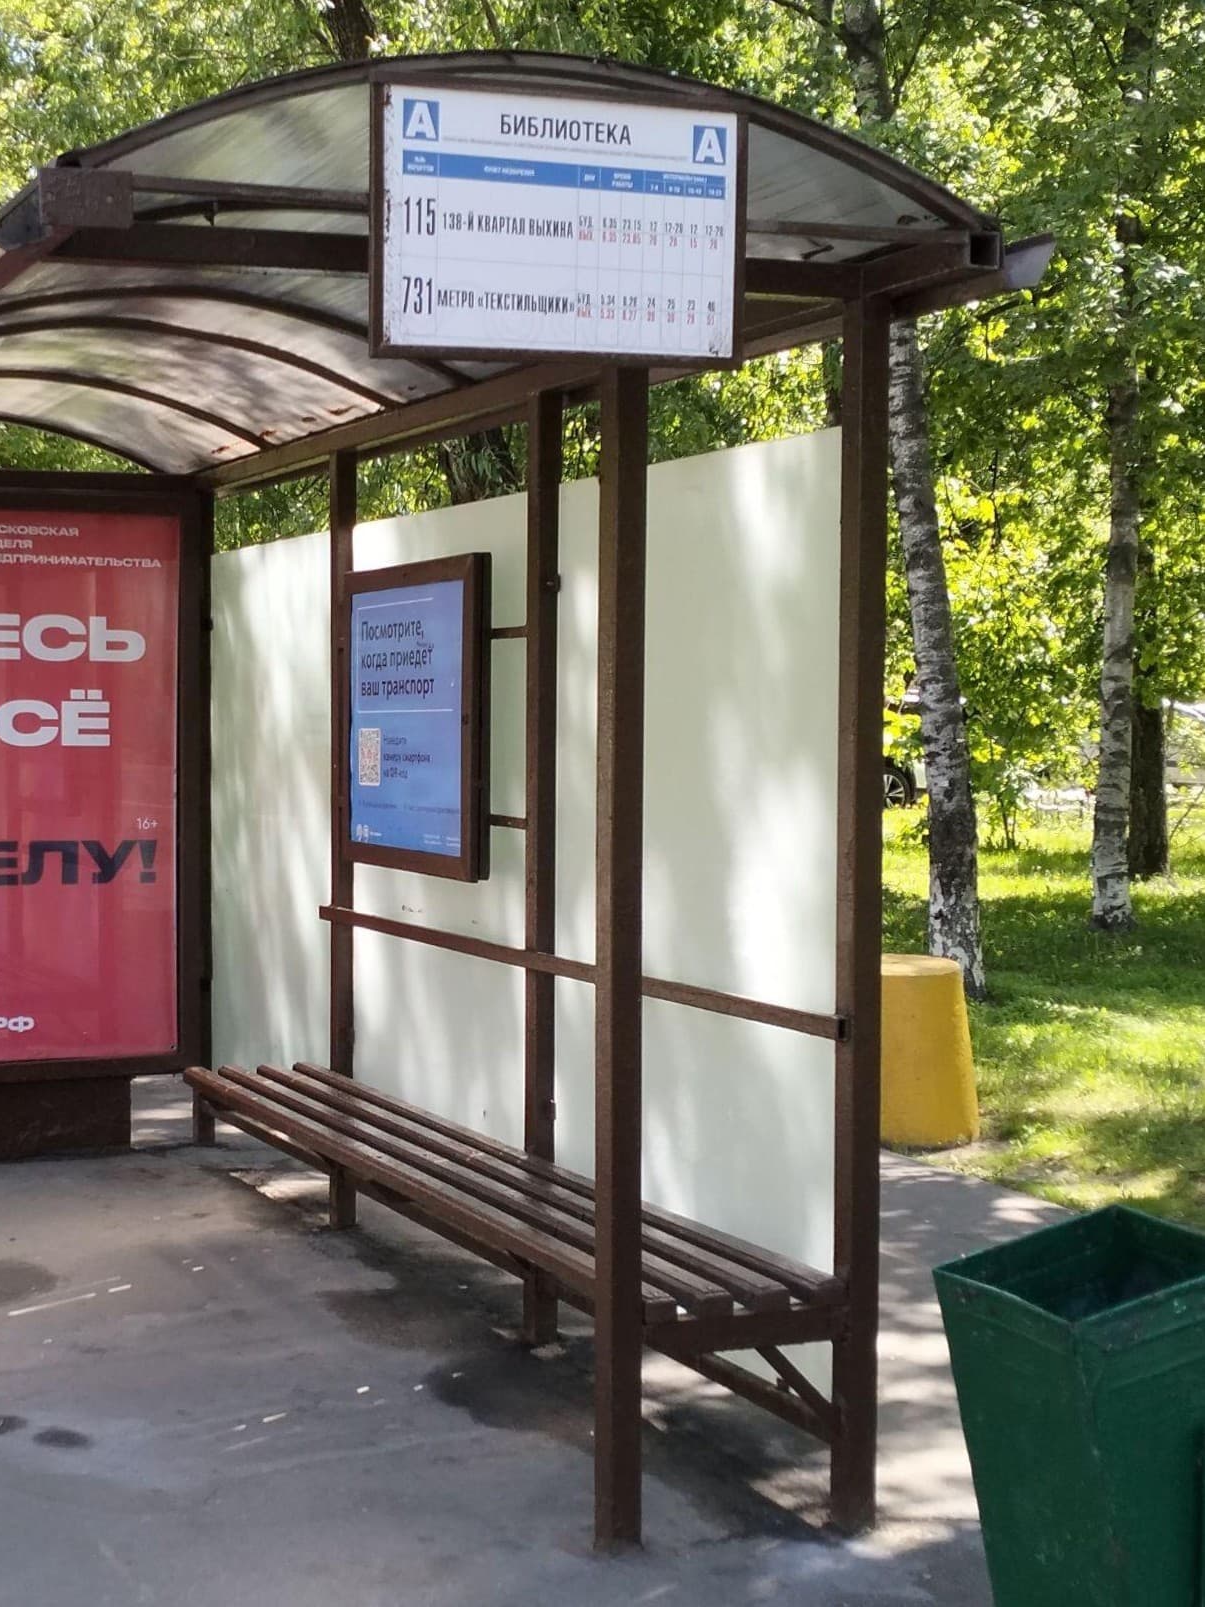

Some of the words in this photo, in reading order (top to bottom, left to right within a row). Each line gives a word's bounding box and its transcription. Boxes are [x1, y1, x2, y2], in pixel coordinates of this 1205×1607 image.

[499, 114, 632, 146] БИБЛИОТЕКА
[404, 196, 436, 236] 115
[443, 211, 474, 232] 138-Й
[477, 214, 526, 236] КВАРТАЛ
[529, 218, 574, 240] ВЫХИНА
[402, 276, 433, 315] 731
[437, 289, 475, 309] МЕТРО
[477, 291, 575, 316] «ТЕКСТИЛЬЩИКИ»
[361, 620, 425, 643] Посмотрите,
[361, 652, 388, 672] когда
[389, 648, 434, 672] приедет
[361, 681, 380, 697] ваш
[382, 678, 435, 700] транспорт
[136, 817, 158, 831] 16+
